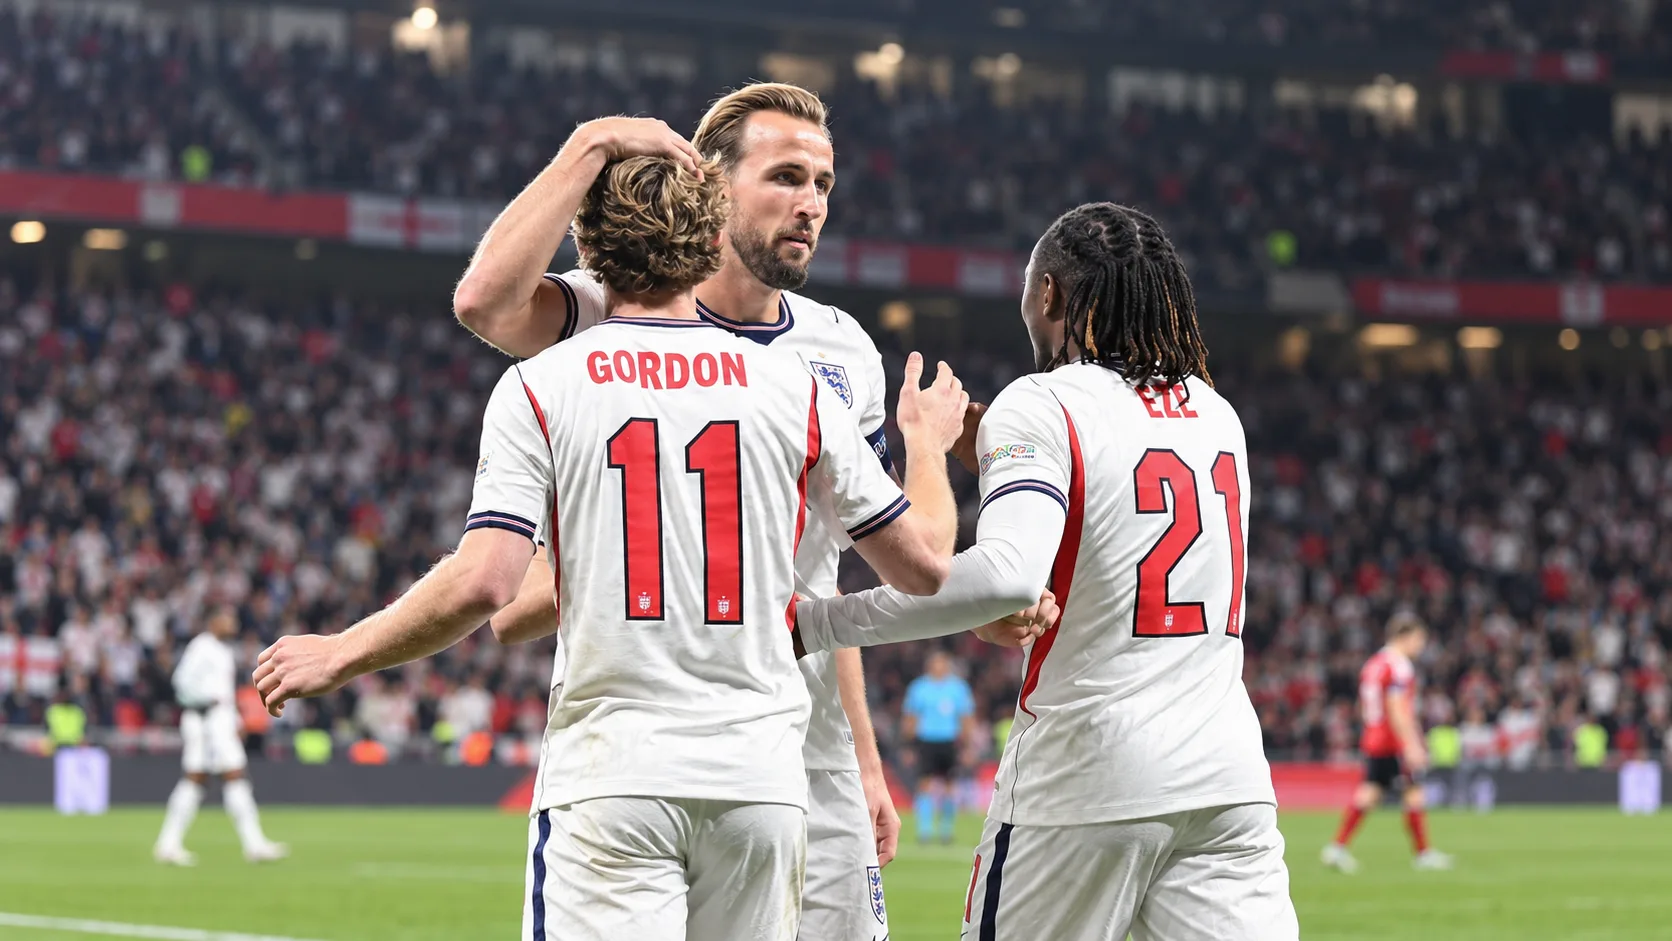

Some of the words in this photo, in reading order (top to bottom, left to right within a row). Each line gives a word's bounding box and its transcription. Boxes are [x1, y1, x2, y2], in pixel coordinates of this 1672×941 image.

[587, 350, 748, 390] GORDON
[1134, 382, 1199, 418] EZE
[606, 417, 744, 625] 11
[1132, 448, 1244, 639] 21
